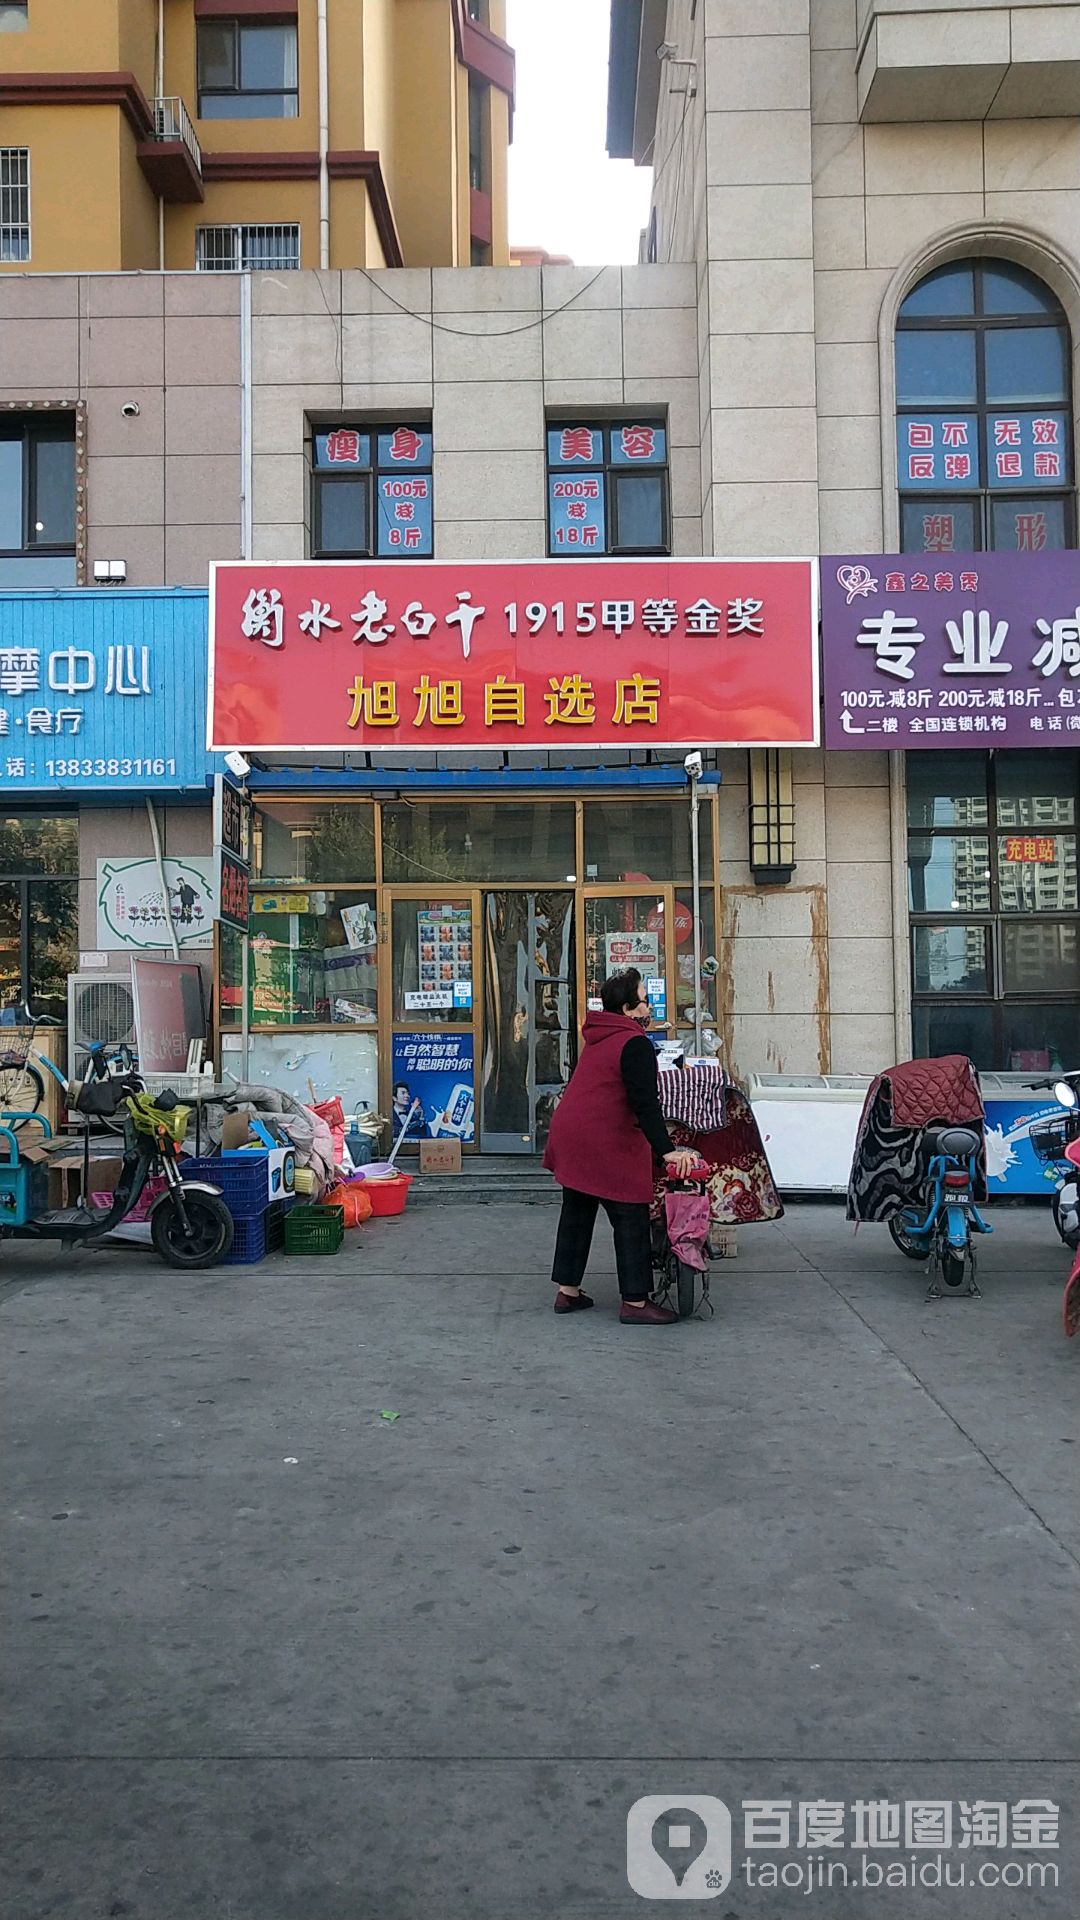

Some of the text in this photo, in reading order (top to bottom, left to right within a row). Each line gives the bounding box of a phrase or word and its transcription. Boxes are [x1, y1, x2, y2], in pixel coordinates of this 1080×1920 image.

[327, 428, 423, 463] 瘦身
[560, 426, 656, 461] 美容
[383, 480, 427, 498] 100元
[554, 480, 599, 498] 200元
[395, 502, 415, 521] 减
[567, 502, 587, 521] 减
[389, 527, 423, 548] 8斤
[555, 527, 599, 547] 18斤
[346, 673, 660, 728] 旭旭自选店
[866, 718, 898, 733] 二楼
[909, 715, 1007, 733] 全国连锁机构
[1006, 839, 1053, 861] 充电站
